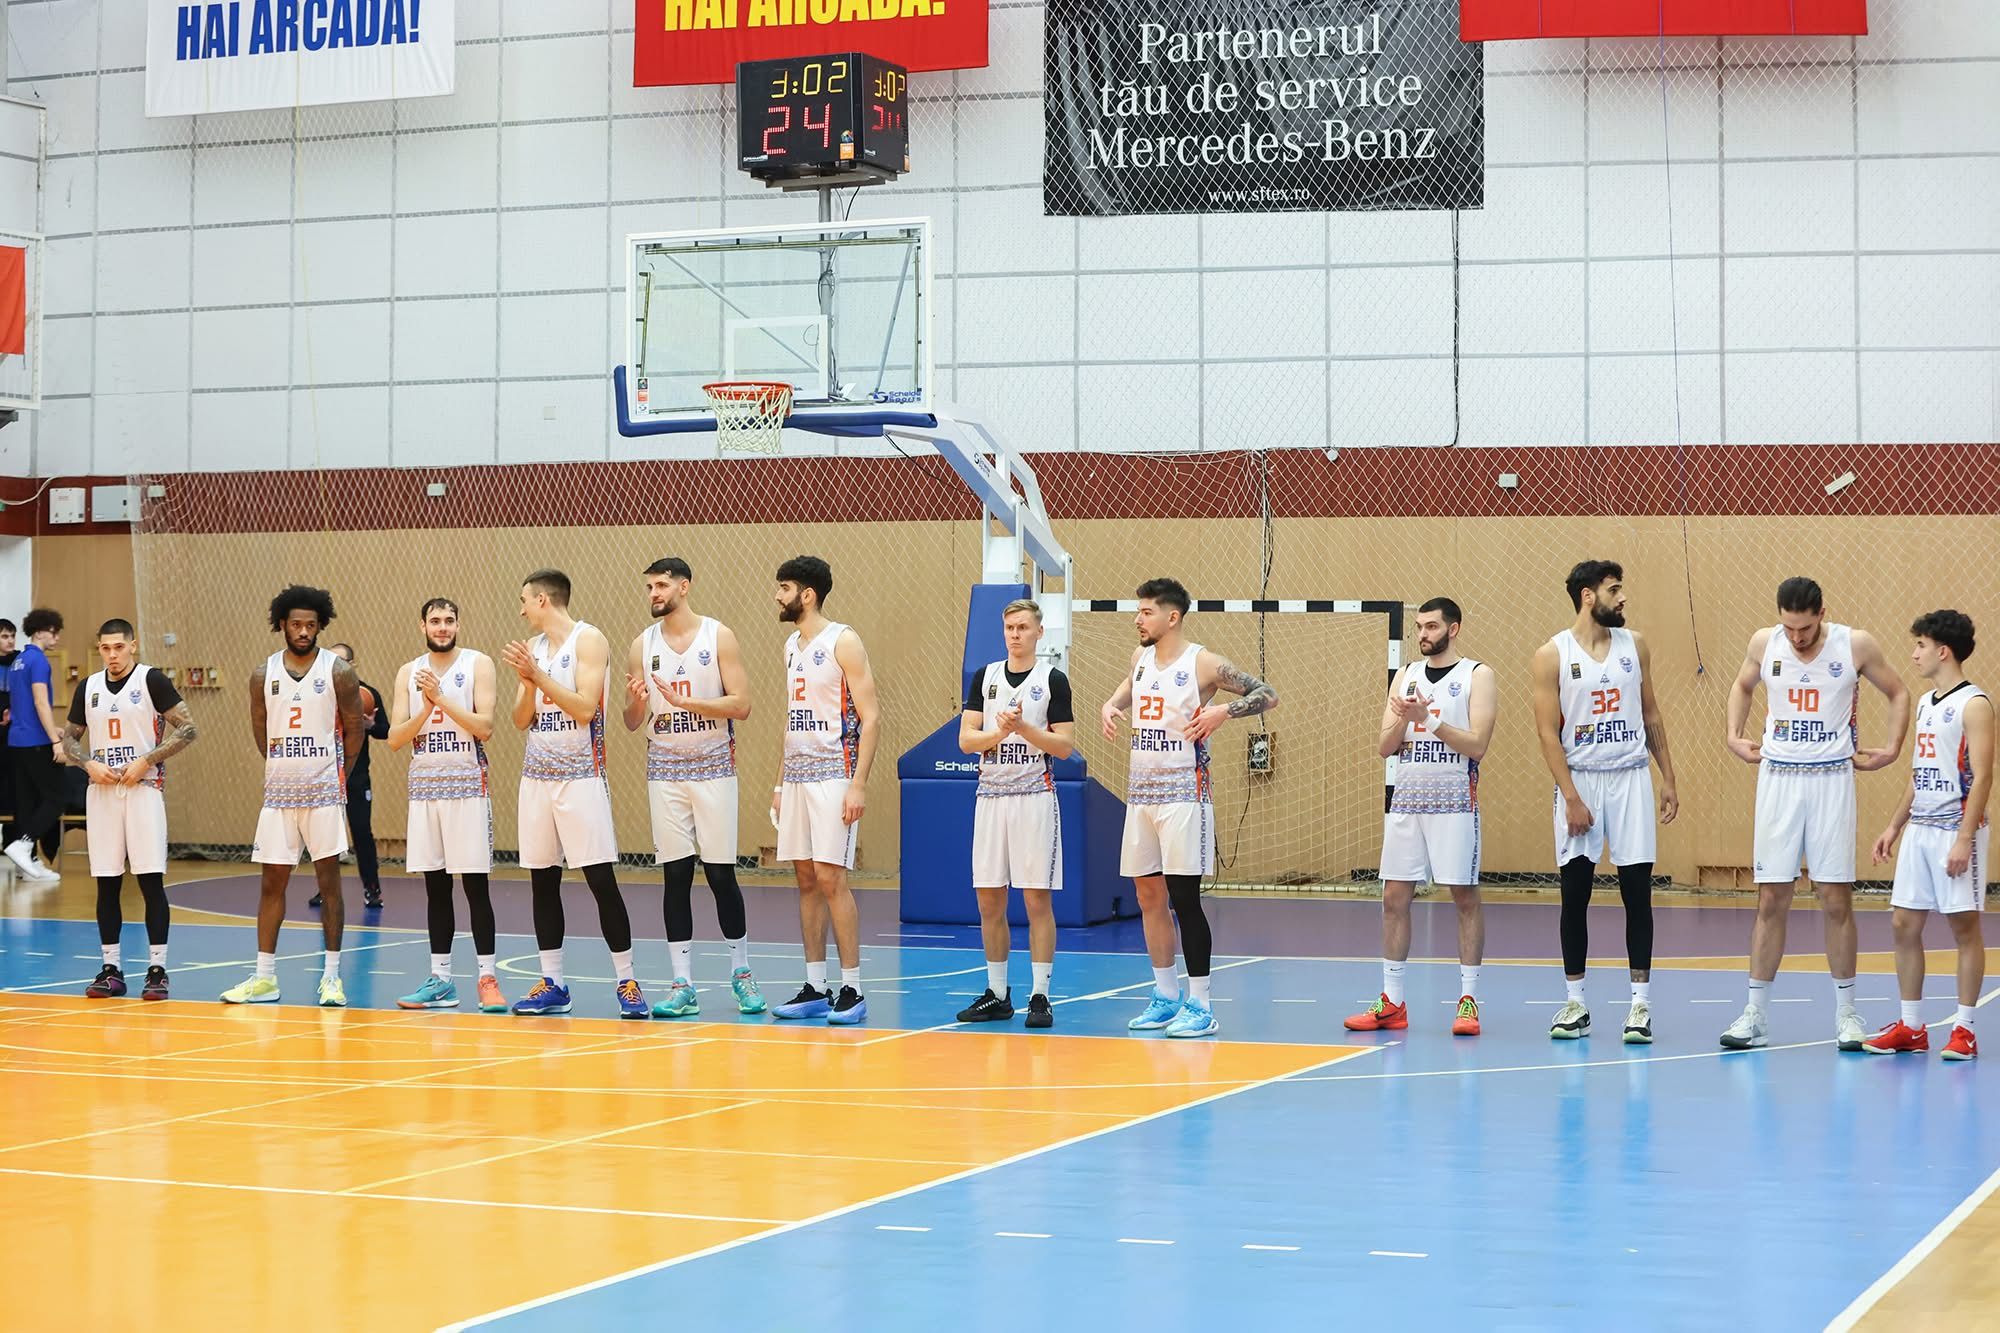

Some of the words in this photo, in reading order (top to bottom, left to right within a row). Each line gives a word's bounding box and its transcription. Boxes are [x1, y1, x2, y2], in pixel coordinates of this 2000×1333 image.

[177, 2, 239, 60] HAI
[249, 0, 420, 54] ARCADA!
[1137, 14, 1382, 65] Partenerul
[1100, 80, 1169, 118] tău
[1187, 72, 1238, 114] de
[1255, 66, 1422, 111] service
[763, 103, 831, 155] 24
[1086, 119, 1436, 171] Mercedes-Benz
[1591, 688, 1620, 714] 32
[1788, 689, 1819, 712] 40
[1139, 696, 1165, 720] 23
[289, 707, 302, 729] 2
[790, 710, 812, 720] CSM
[109, 718, 121, 739] 0
[790, 720, 828, 731] GALATI
[1597, 720, 1626, 732] CSM
[1792, 721, 1824, 731] CSM
[428, 731, 456, 742] CSM
[1141, 729, 1166, 740] CSM
[286, 736, 314, 747] CSM
[428, 741, 471, 752] GALATI
[1141, 740, 1182, 751] GALATI
[1415, 741, 1444, 752] CSM
[1917, 733, 1936, 758] 55
[107, 746, 134, 757] CSM
[286, 747, 328, 757] GALATI
[1000, 743, 1027, 754] CSM
[1414, 752, 1460, 764] GALATI
